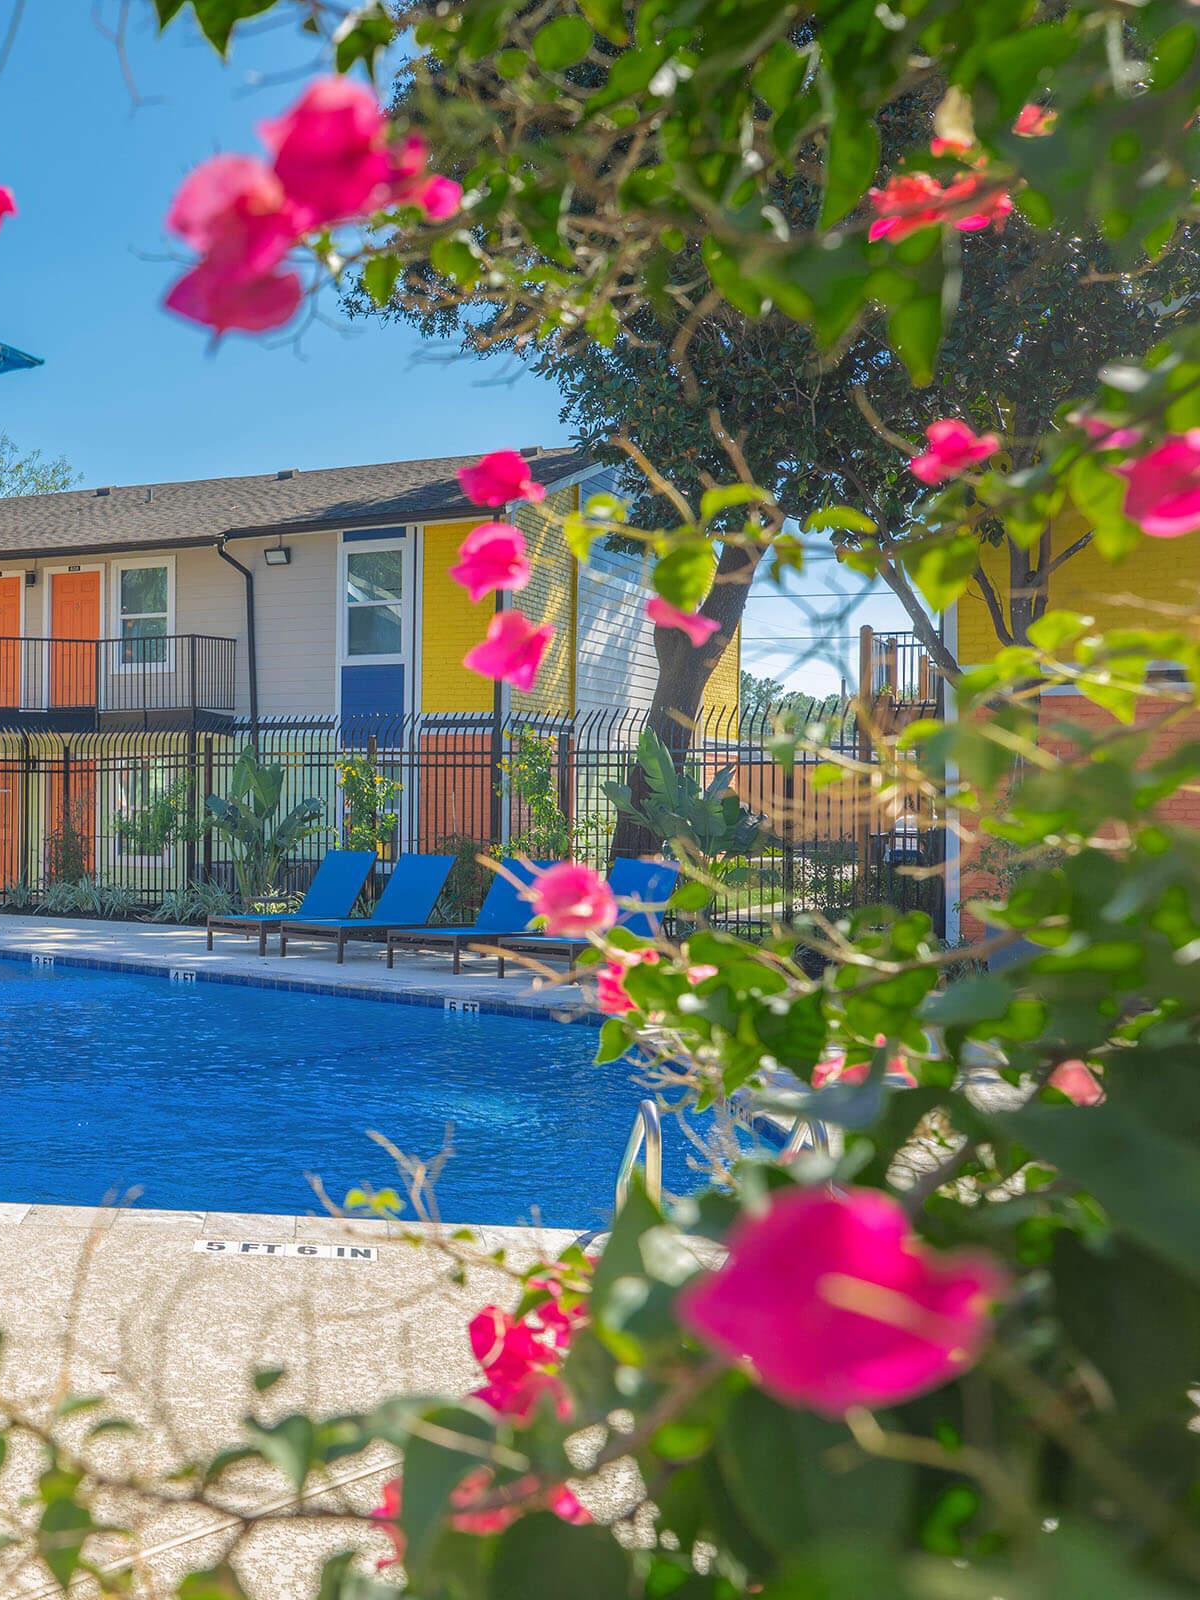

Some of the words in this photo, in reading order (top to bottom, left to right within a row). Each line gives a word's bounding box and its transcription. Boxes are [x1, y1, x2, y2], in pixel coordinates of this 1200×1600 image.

[183, 972, 194, 982] FT
[463, 1002, 477, 1013] FT
[206, 1241, 226, 1251] 5
[241, 1243, 282, 1254] FT
[297, 1246, 318, 1255] 6
[337, 1247, 372, 1259] IN
